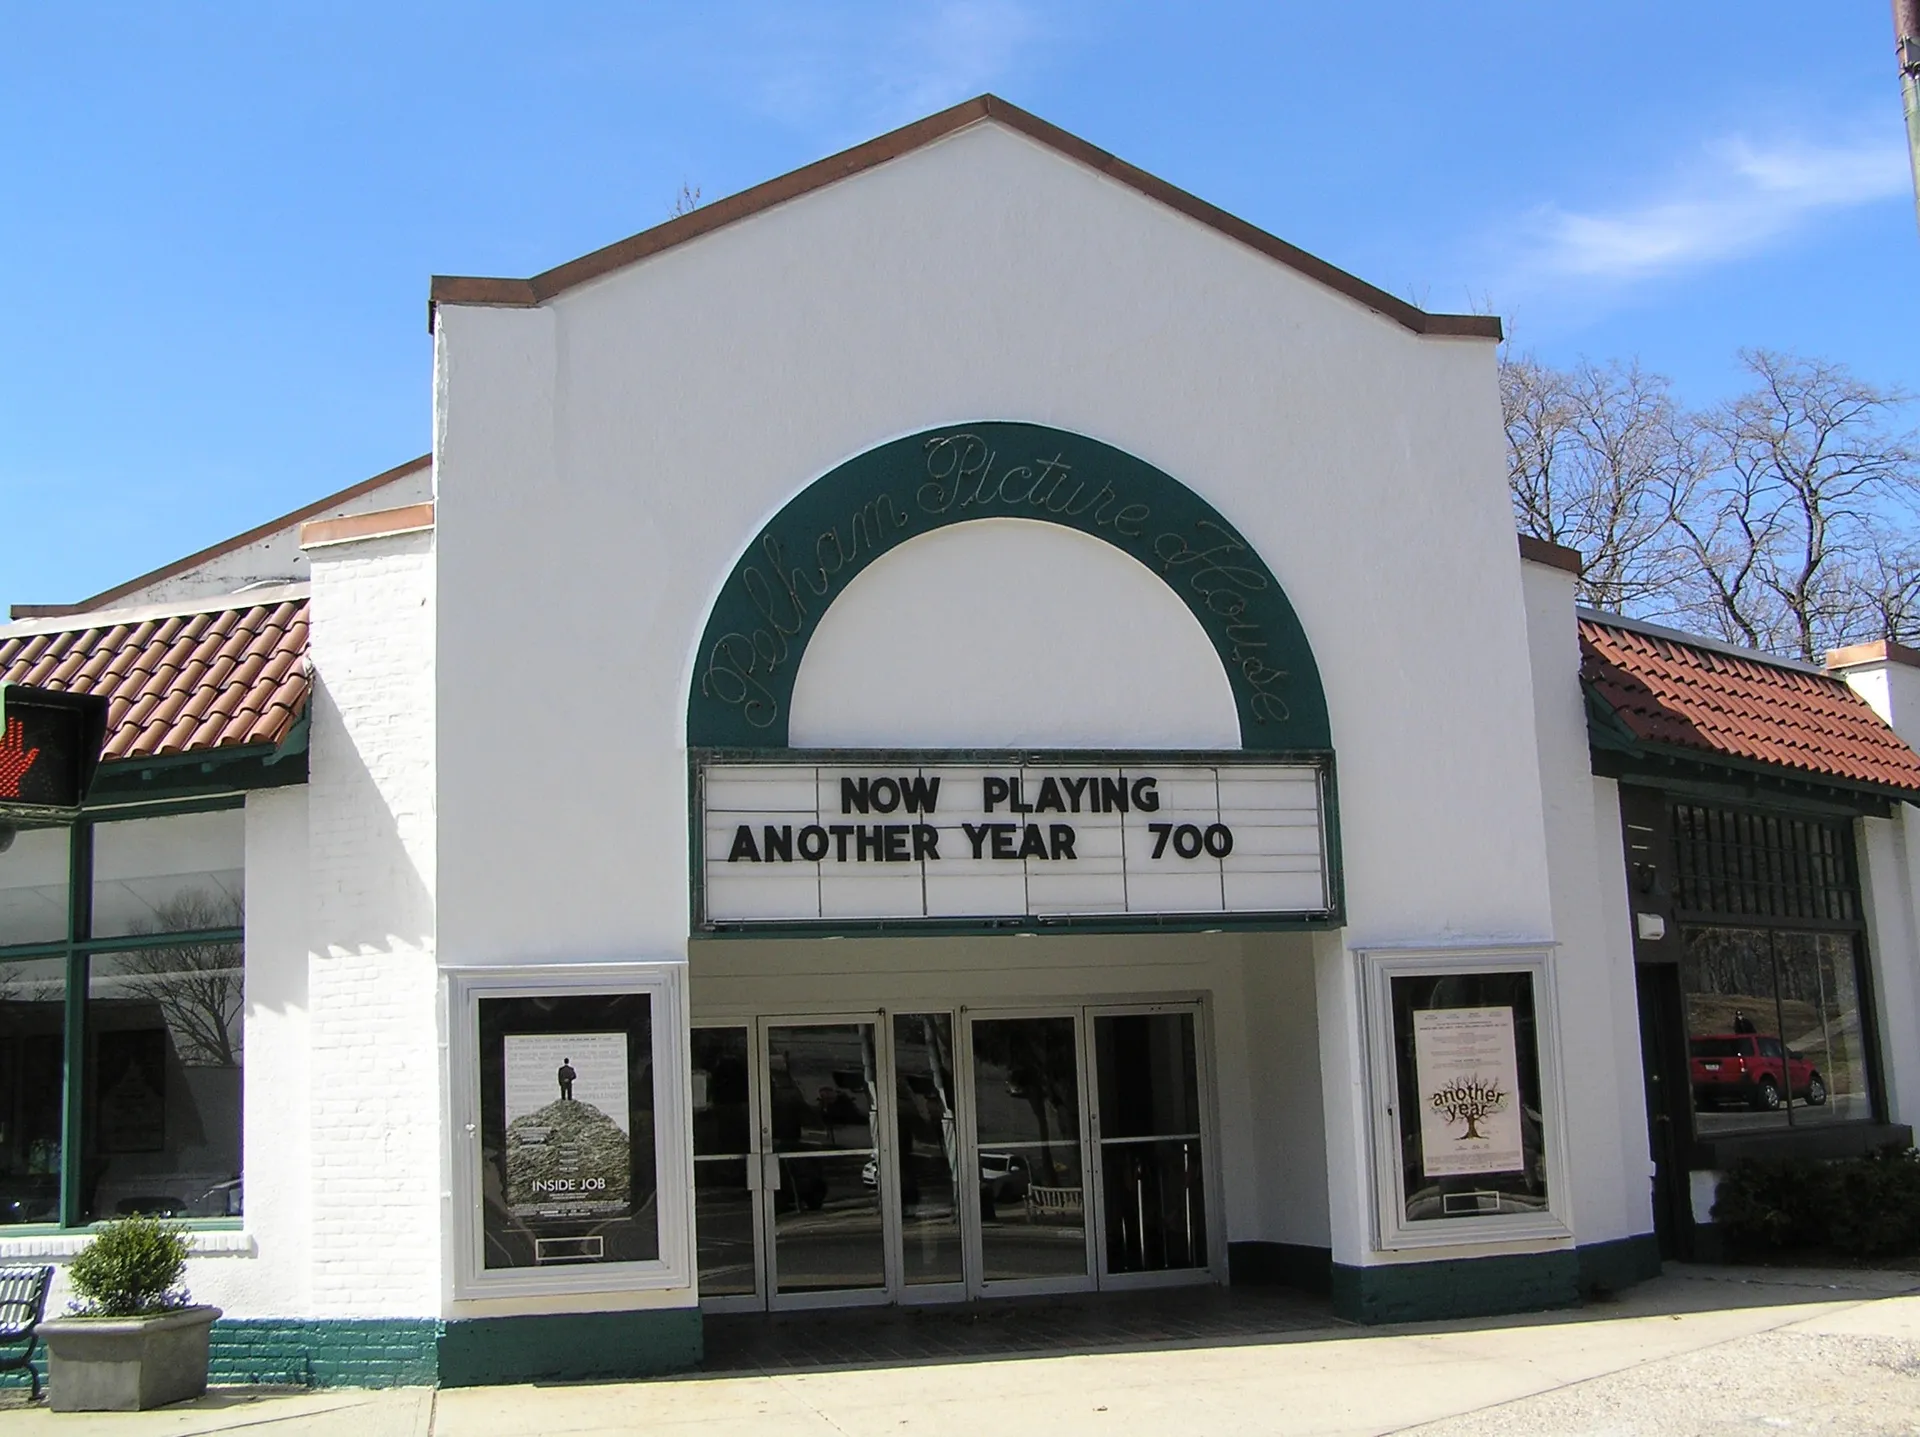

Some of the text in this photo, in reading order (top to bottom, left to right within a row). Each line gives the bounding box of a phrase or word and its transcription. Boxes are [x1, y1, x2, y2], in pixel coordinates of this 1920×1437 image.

[703, 434, 1290, 728] Pelham Picture House
[841, 776, 1159, 814] NOW PLAYING
[727, 823, 1234, 863] ANOTHER YEAR 700
[1433, 1083, 1505, 1107] another
[1446, 1102, 1489, 1125] year
[532, 1177, 607, 1192] INSIDE JOB
